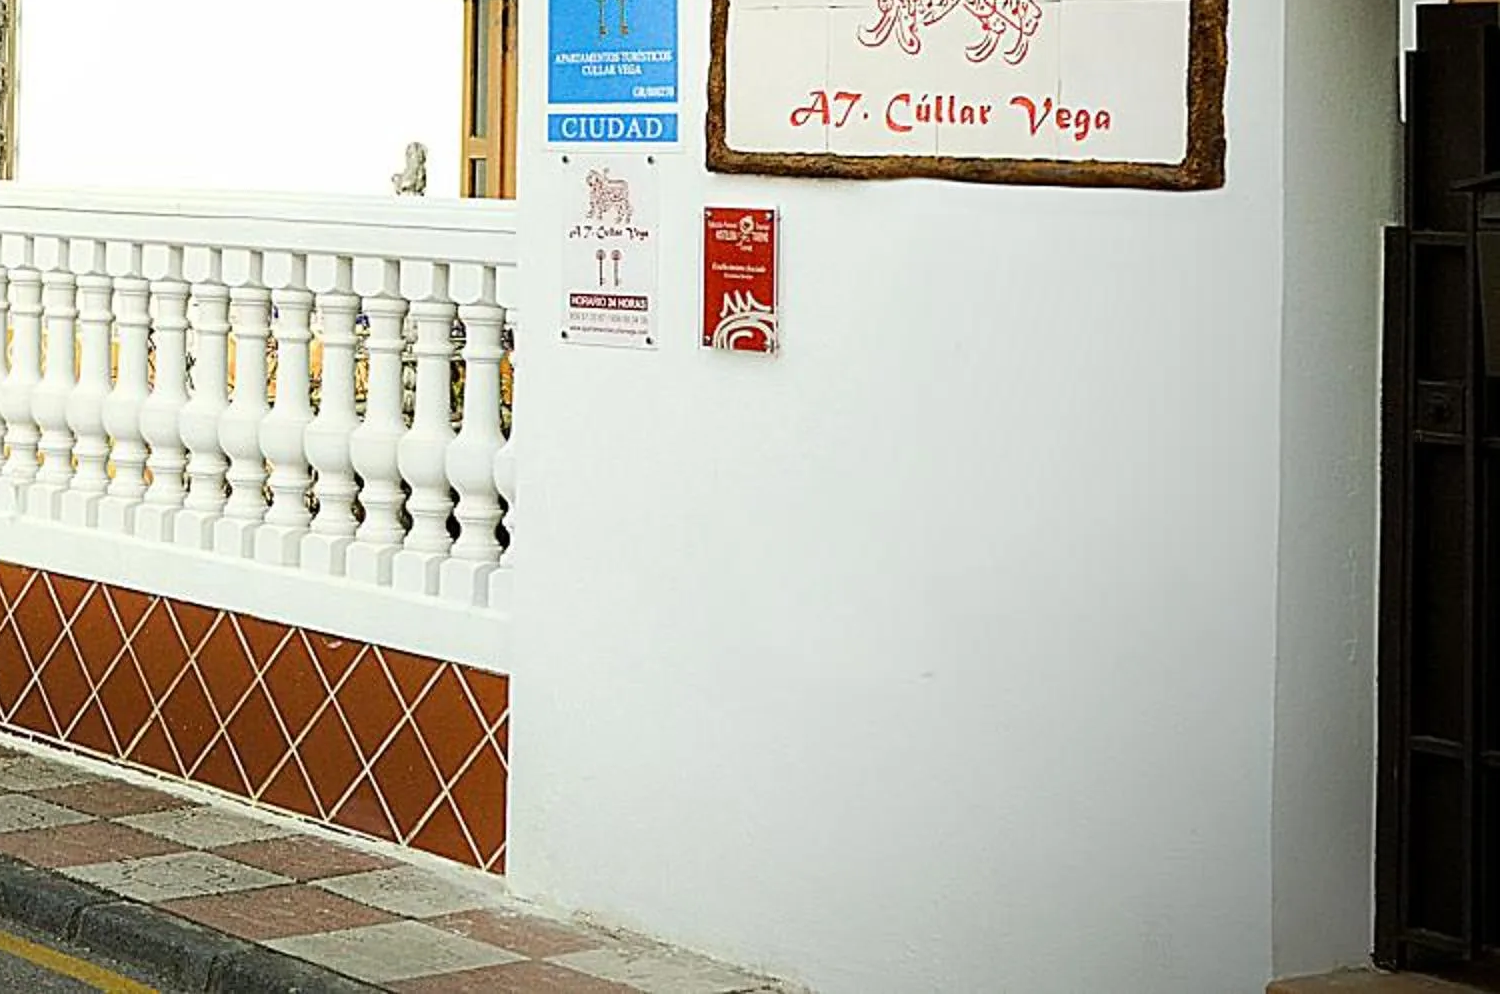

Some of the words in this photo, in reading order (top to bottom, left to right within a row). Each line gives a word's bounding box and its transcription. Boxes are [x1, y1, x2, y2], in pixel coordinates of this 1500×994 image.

[561, 117, 663, 139] CIUDAD
[885, 93, 993, 133] Cúllar
[1009, 95, 1111, 142] Vega
